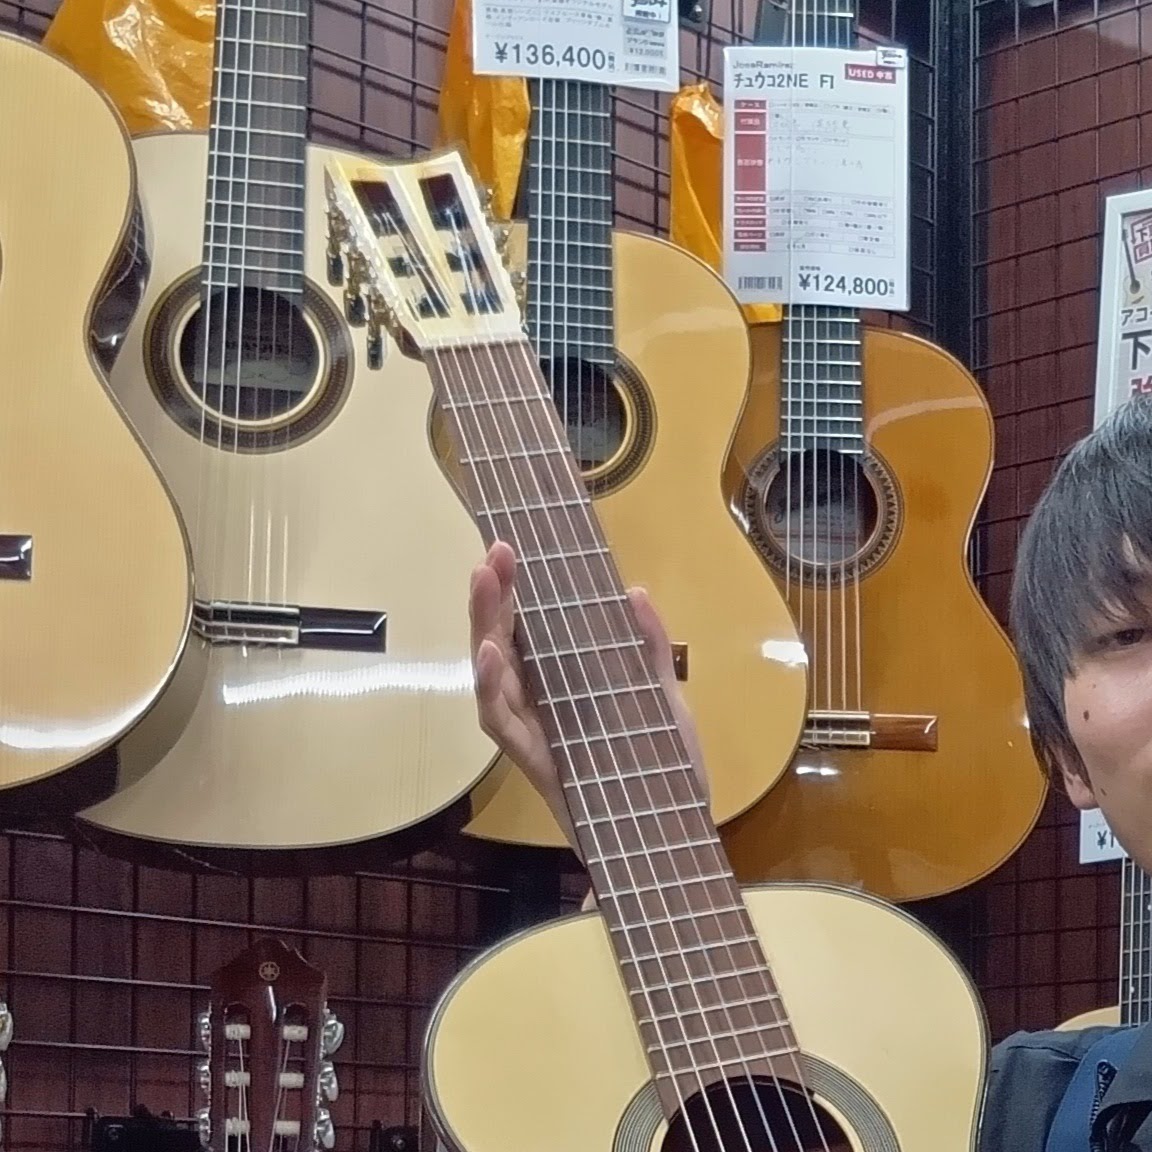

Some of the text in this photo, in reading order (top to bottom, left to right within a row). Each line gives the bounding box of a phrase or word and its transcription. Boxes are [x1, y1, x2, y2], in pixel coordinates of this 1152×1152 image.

[495, 42, 606, 70] ¥136,400
[734, 71, 809, 88] チュウコ2NE
[848, 68, 873, 78] USED
[798, 273, 888, 296] ¥124,800
